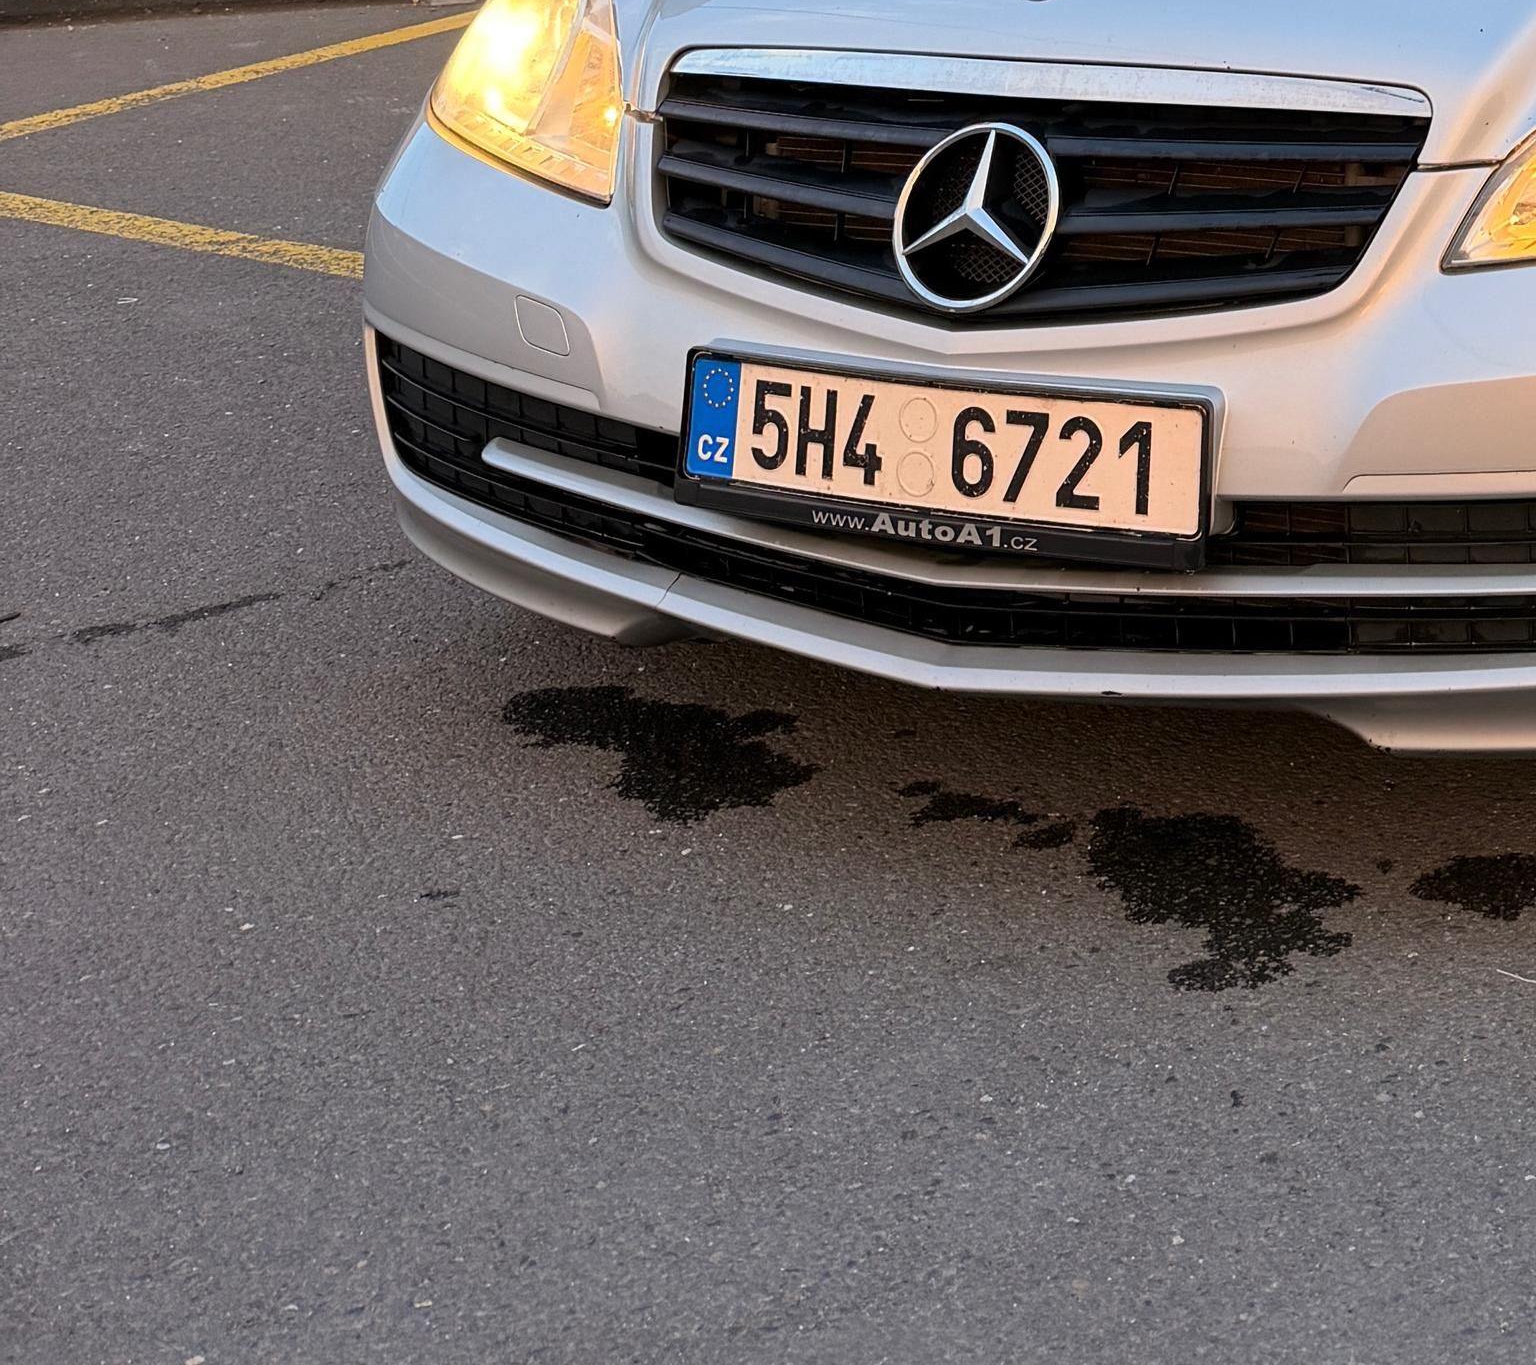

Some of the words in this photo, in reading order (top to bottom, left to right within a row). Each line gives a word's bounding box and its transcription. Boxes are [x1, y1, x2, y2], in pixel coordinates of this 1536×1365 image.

[697, 434, 730, 463] CZ
[751, 379, 883, 486] 5H4
[951, 406, 1152, 516] 6721
[811, 509, 1039, 552] www.AutoA1.cz
